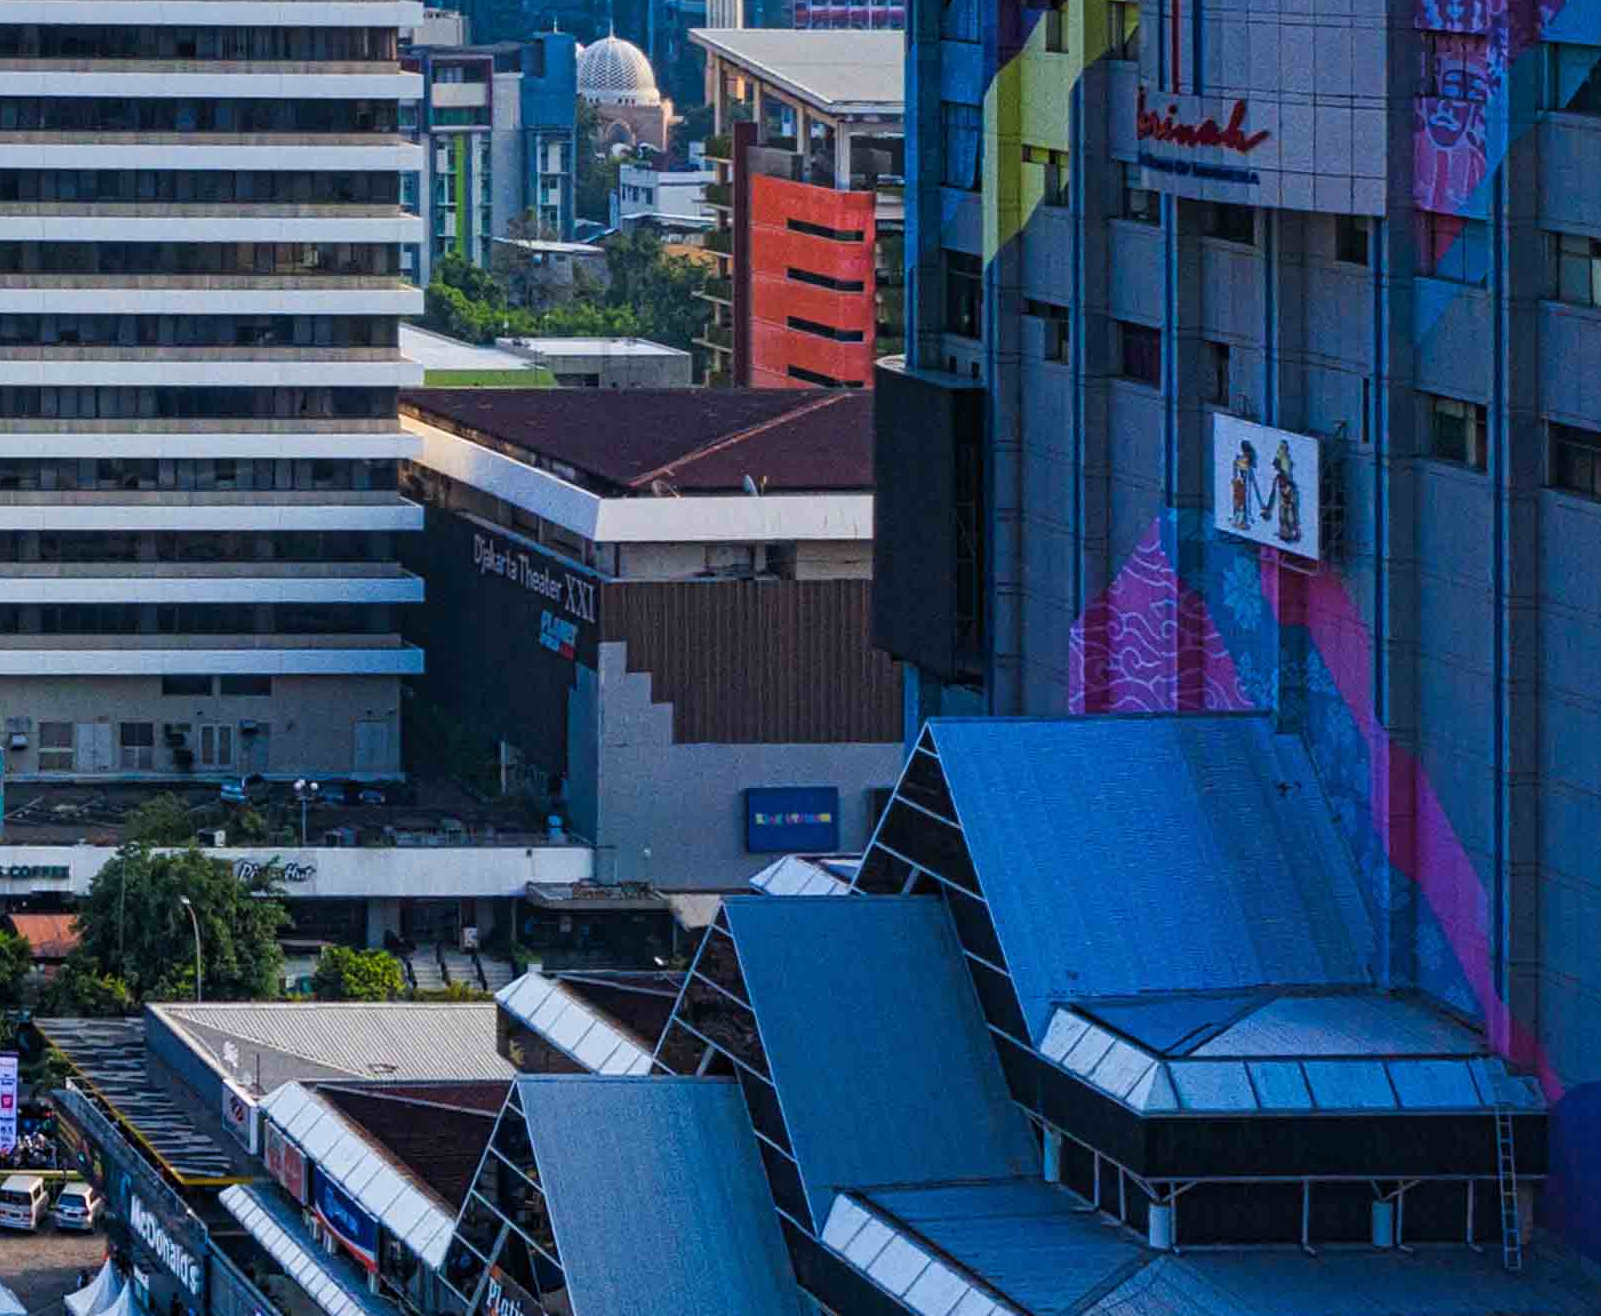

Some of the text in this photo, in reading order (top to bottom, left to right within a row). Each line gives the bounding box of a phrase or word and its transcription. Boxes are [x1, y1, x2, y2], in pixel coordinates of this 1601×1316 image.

[474, 533, 596, 624] Djakarta Theater XXI
[5, 863, 70, 880] COFFEE
